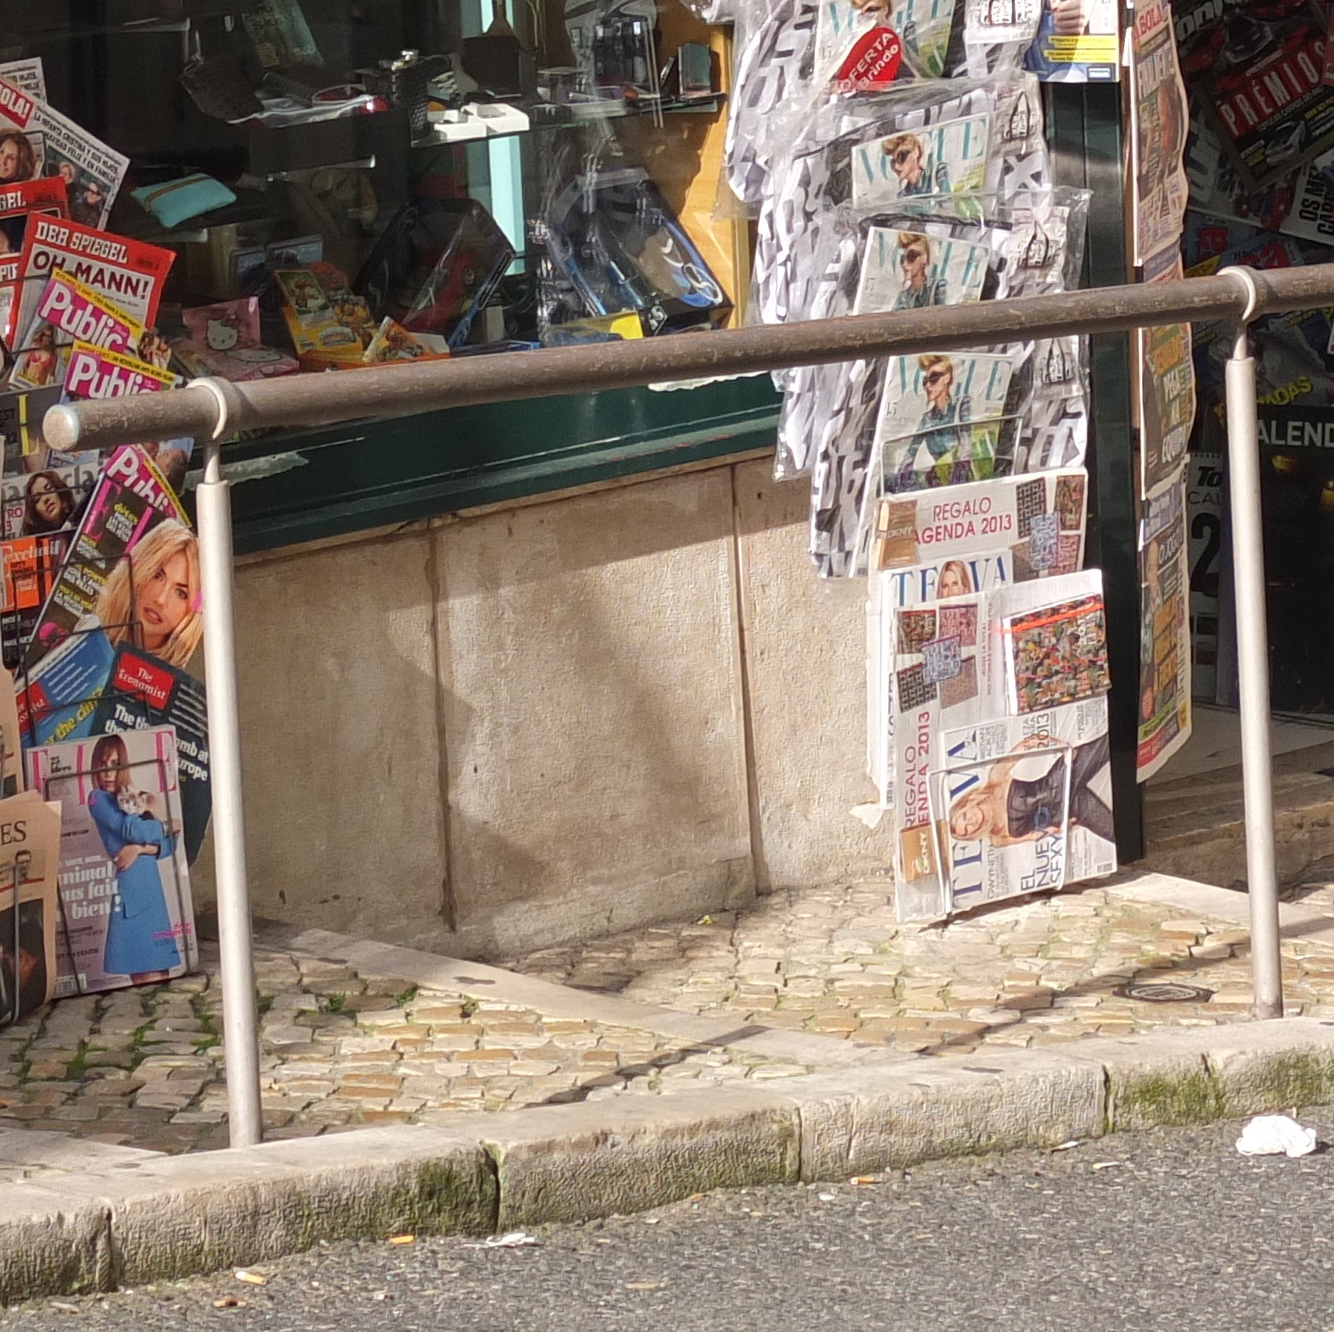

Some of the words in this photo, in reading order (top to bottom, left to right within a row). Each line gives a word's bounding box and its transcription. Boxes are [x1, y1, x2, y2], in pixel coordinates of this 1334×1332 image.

[35, 220, 69, 245] DER
[69, 230, 129, 265] SPIEGEL
[73, 260, 151, 300] MANN!
[41, 283, 124, 352] Public
[932, 497, 991, 523] REGALO
[981, 514, 1012, 535] 2013
[113, 704, 133, 726] The
[917, 710, 931, 756] 2013
[87, 876, 119, 897] fait
[1021, 868, 1036, 891] EL
[72, 894, 123, 920] bien!
